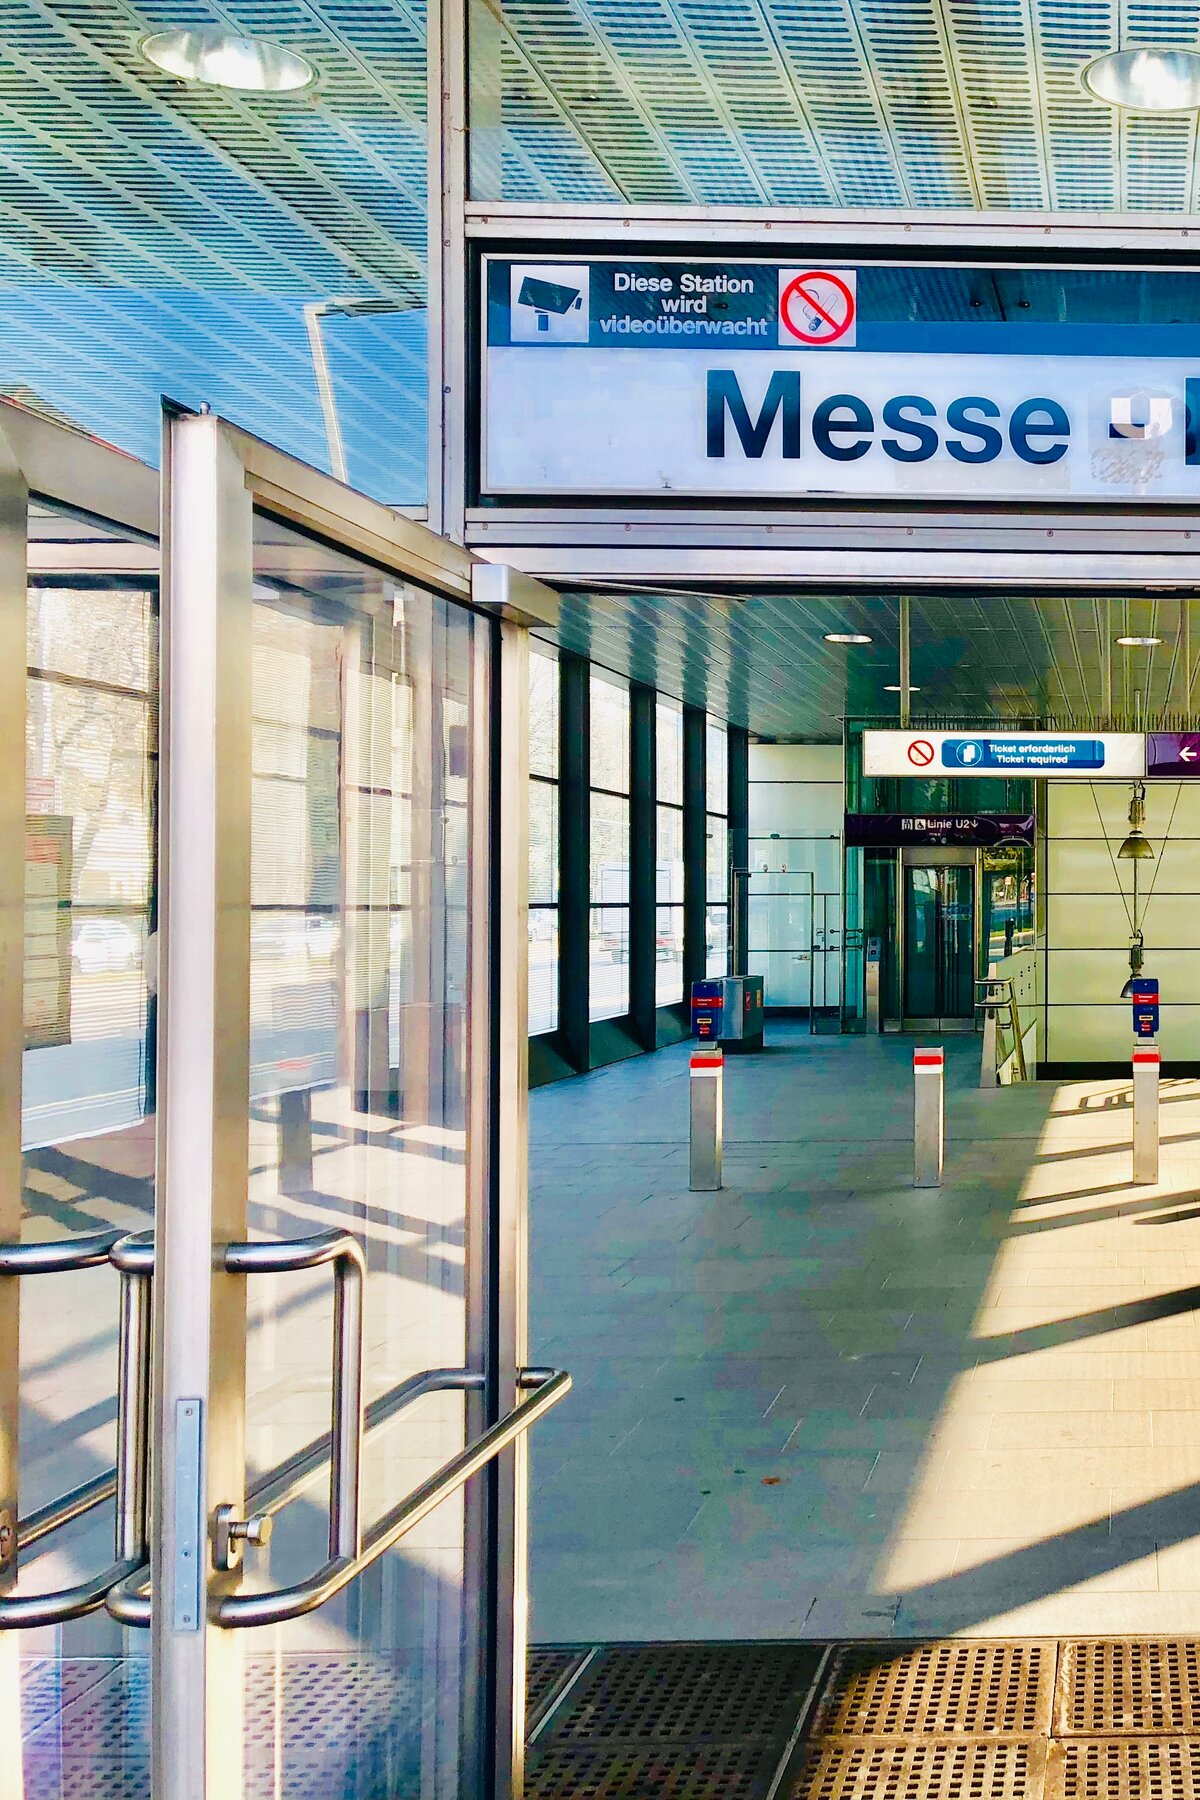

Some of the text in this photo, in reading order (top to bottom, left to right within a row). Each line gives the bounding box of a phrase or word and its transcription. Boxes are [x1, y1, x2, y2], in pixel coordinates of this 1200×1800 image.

[614, 273, 754, 293] Diese Station
[661, 295, 707, 314] wird
[600, 315, 768, 336] videoüberwacht
[706, 369, 1071, 465] Messe
[988, 744, 1076, 753] Ticket erforderlich
[996, 755, 1068, 765] Ticket required
[927, 819, 970, 829] Linie U2
